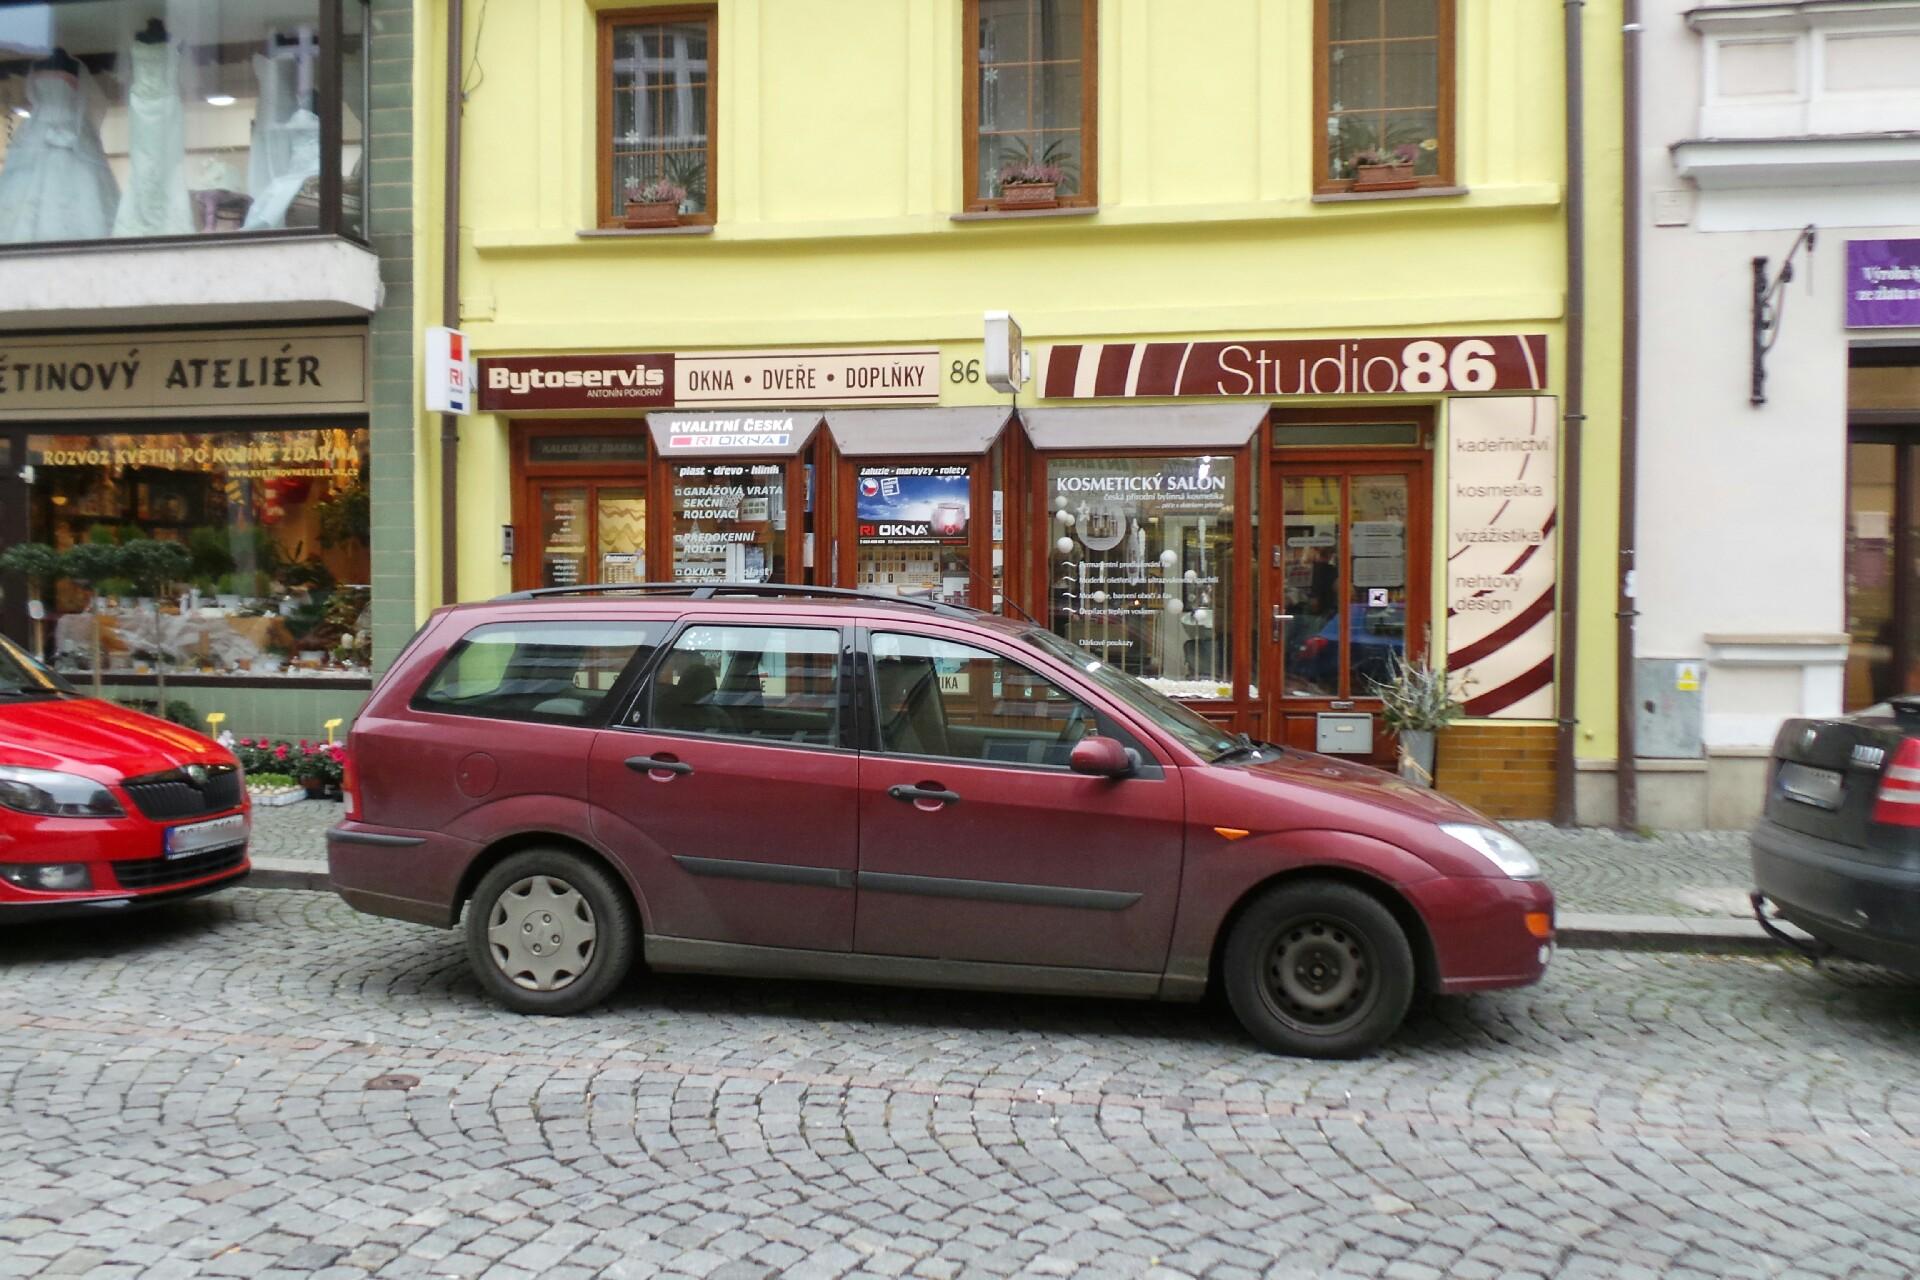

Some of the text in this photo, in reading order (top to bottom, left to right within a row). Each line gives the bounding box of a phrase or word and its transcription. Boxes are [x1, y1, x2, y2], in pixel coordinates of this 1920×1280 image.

[165, 342, 322, 390] ATELIÉR
[950, 359, 980, 384] 86
[488, 364, 665, 394] Bytoservis
[689, 361, 925, 391] OKNA DVEŘE DOPLŇKY
[587, 387, 664, 398] ANTONÍN POKORNÝ
[670, 416, 794, 433] KVALITNÍ ČESKÁ
[696, 435, 774, 446] RI OKNA
[1456, 436, 1550, 452] kadeřnictví
[42, 451, 110, 465] ROZVOZ
[115, 444, 176, 464] KVĚTIN
[281, 445, 359, 463] ZDARMA
[680, 464, 779, 477] plast dřevo hliník
[896, 466, 934, 476] markýzy
[940, 466, 967, 476] rolety
[1057, 472, 1163, 491] KOSMETICKÝ
[683, 484, 783, 496] GARÁŽOVÁ VRATA
[1456, 483, 1543, 497] kosmetika
[683, 497, 723, 508] SEKČNÍ
[683, 508, 739, 519] ROLOVACÍ
[683, 530, 756, 542] PŘEDOKENNÍ
[860, 524, 927, 536] RI OKNA
[1455, 529, 1541, 543] vizážistika
[683, 544, 726, 554] ROLETY
[684, 567, 715, 576] OKNA
[1455, 575, 1522, 590] nehtový
[1455, 598, 1513, 614] design
